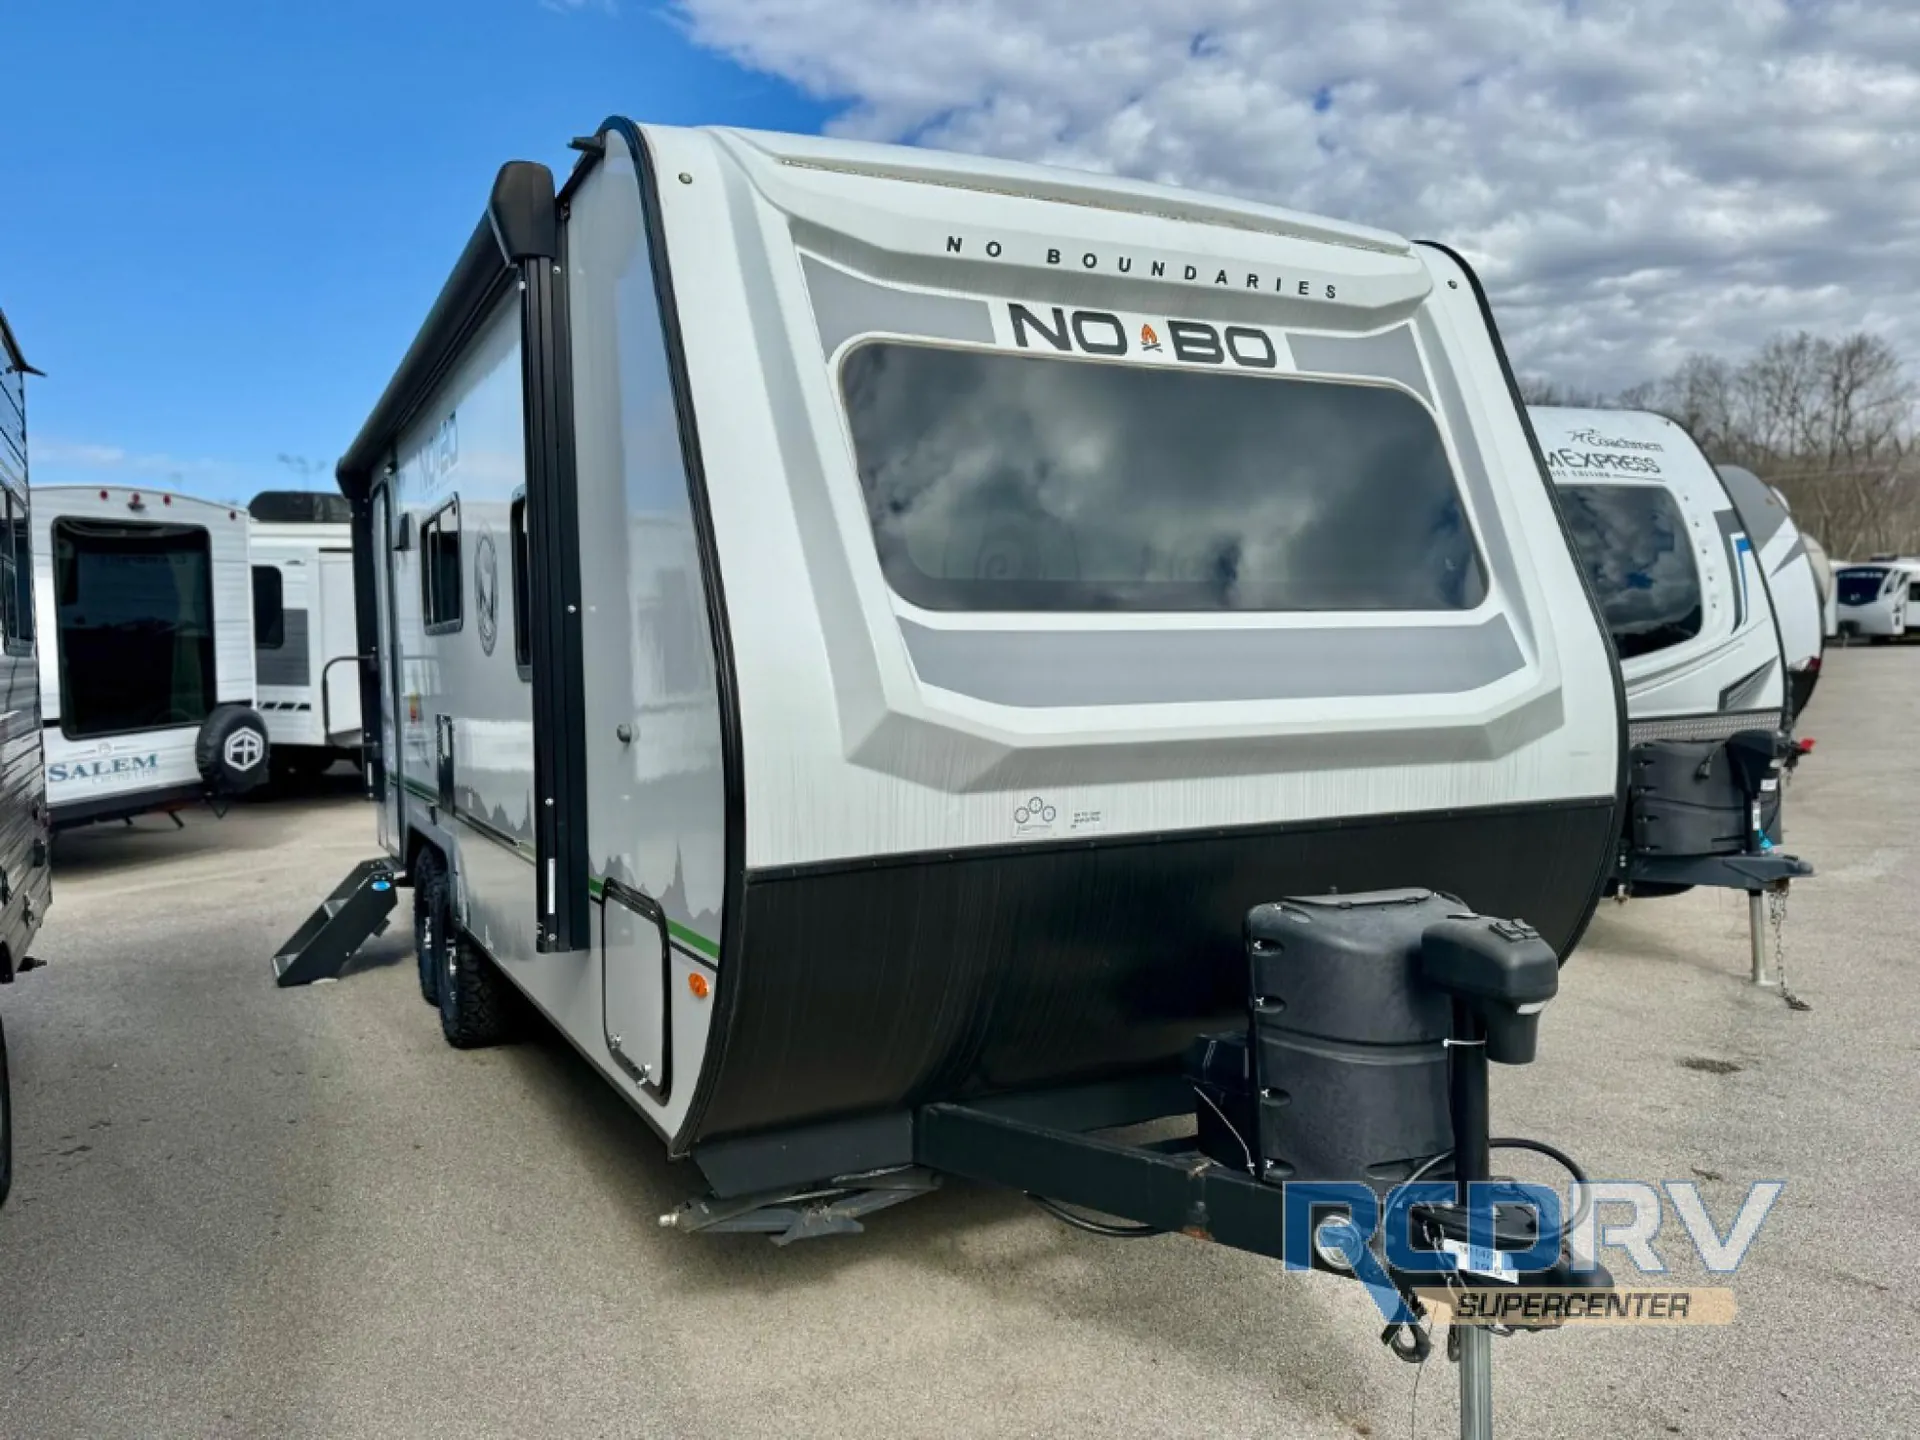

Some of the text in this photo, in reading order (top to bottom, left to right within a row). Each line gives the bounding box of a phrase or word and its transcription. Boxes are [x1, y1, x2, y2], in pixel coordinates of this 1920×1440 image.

[945, 235, 1336, 299] NO BOUNDARIES
[1007, 302, 1277, 368] NO BO
[48, 754, 158, 782] SALEM
